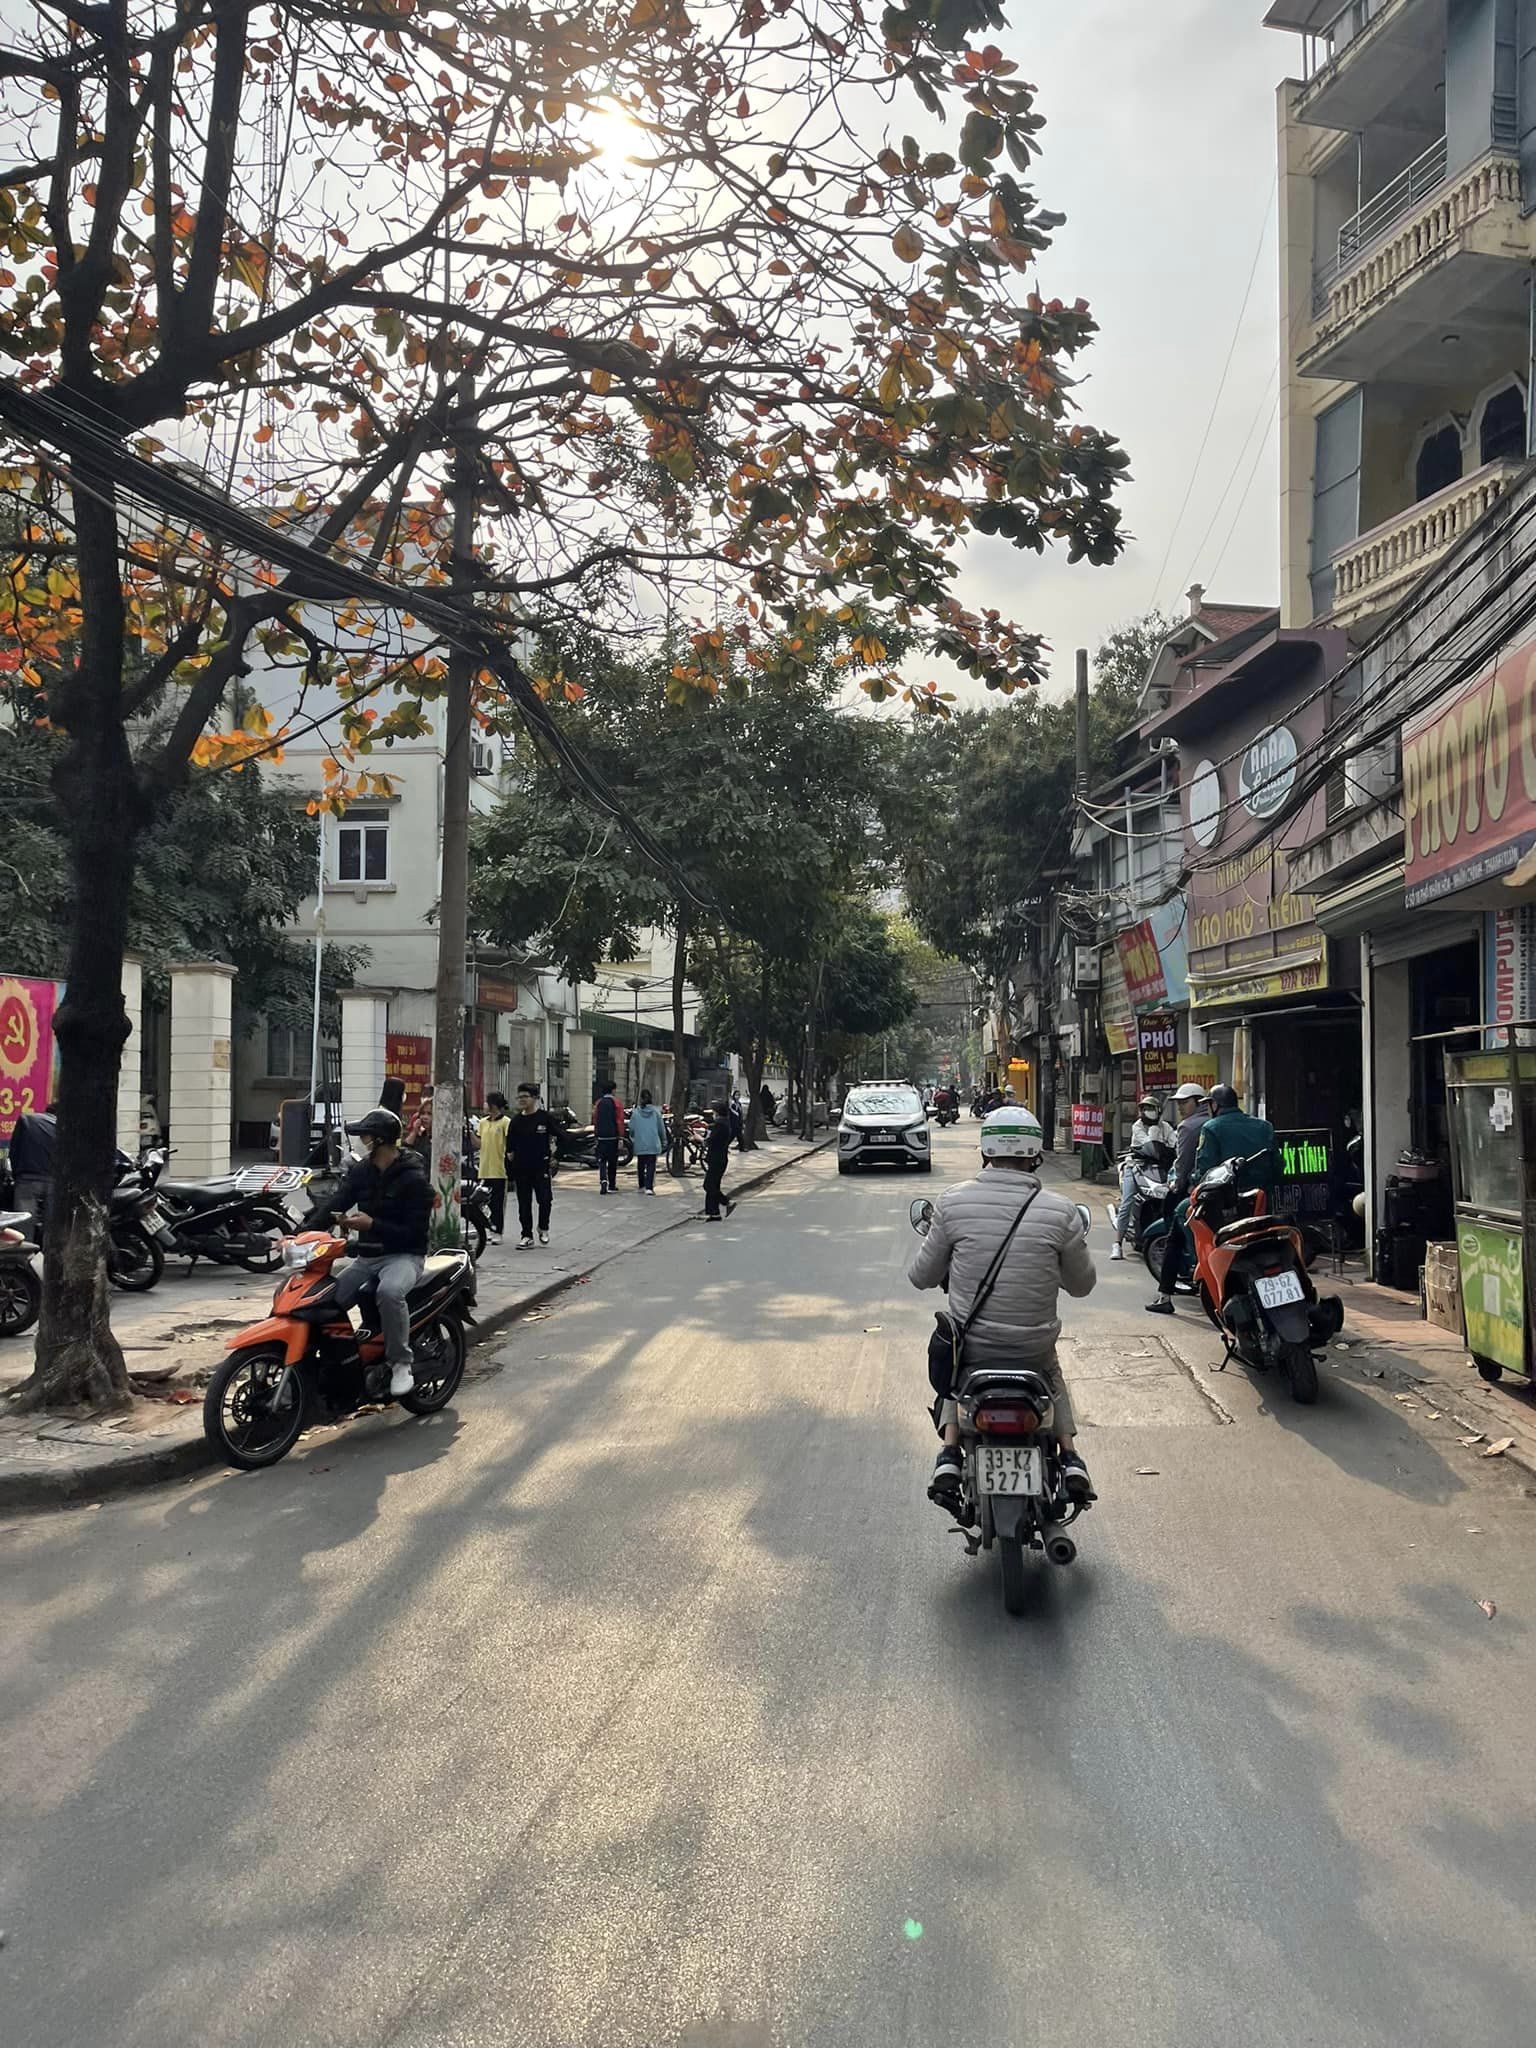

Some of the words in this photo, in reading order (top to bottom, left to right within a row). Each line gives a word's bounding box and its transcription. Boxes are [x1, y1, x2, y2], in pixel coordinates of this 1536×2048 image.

[1403, 680, 1509, 866] PHOTO
[1140, 1025, 1175, 1049] PHỞ
[1278, 1141, 1295, 1175] ÁY
[1297, 1140, 1327, 1174] TÍNH
[986, 1471, 1031, 1491] 5271
